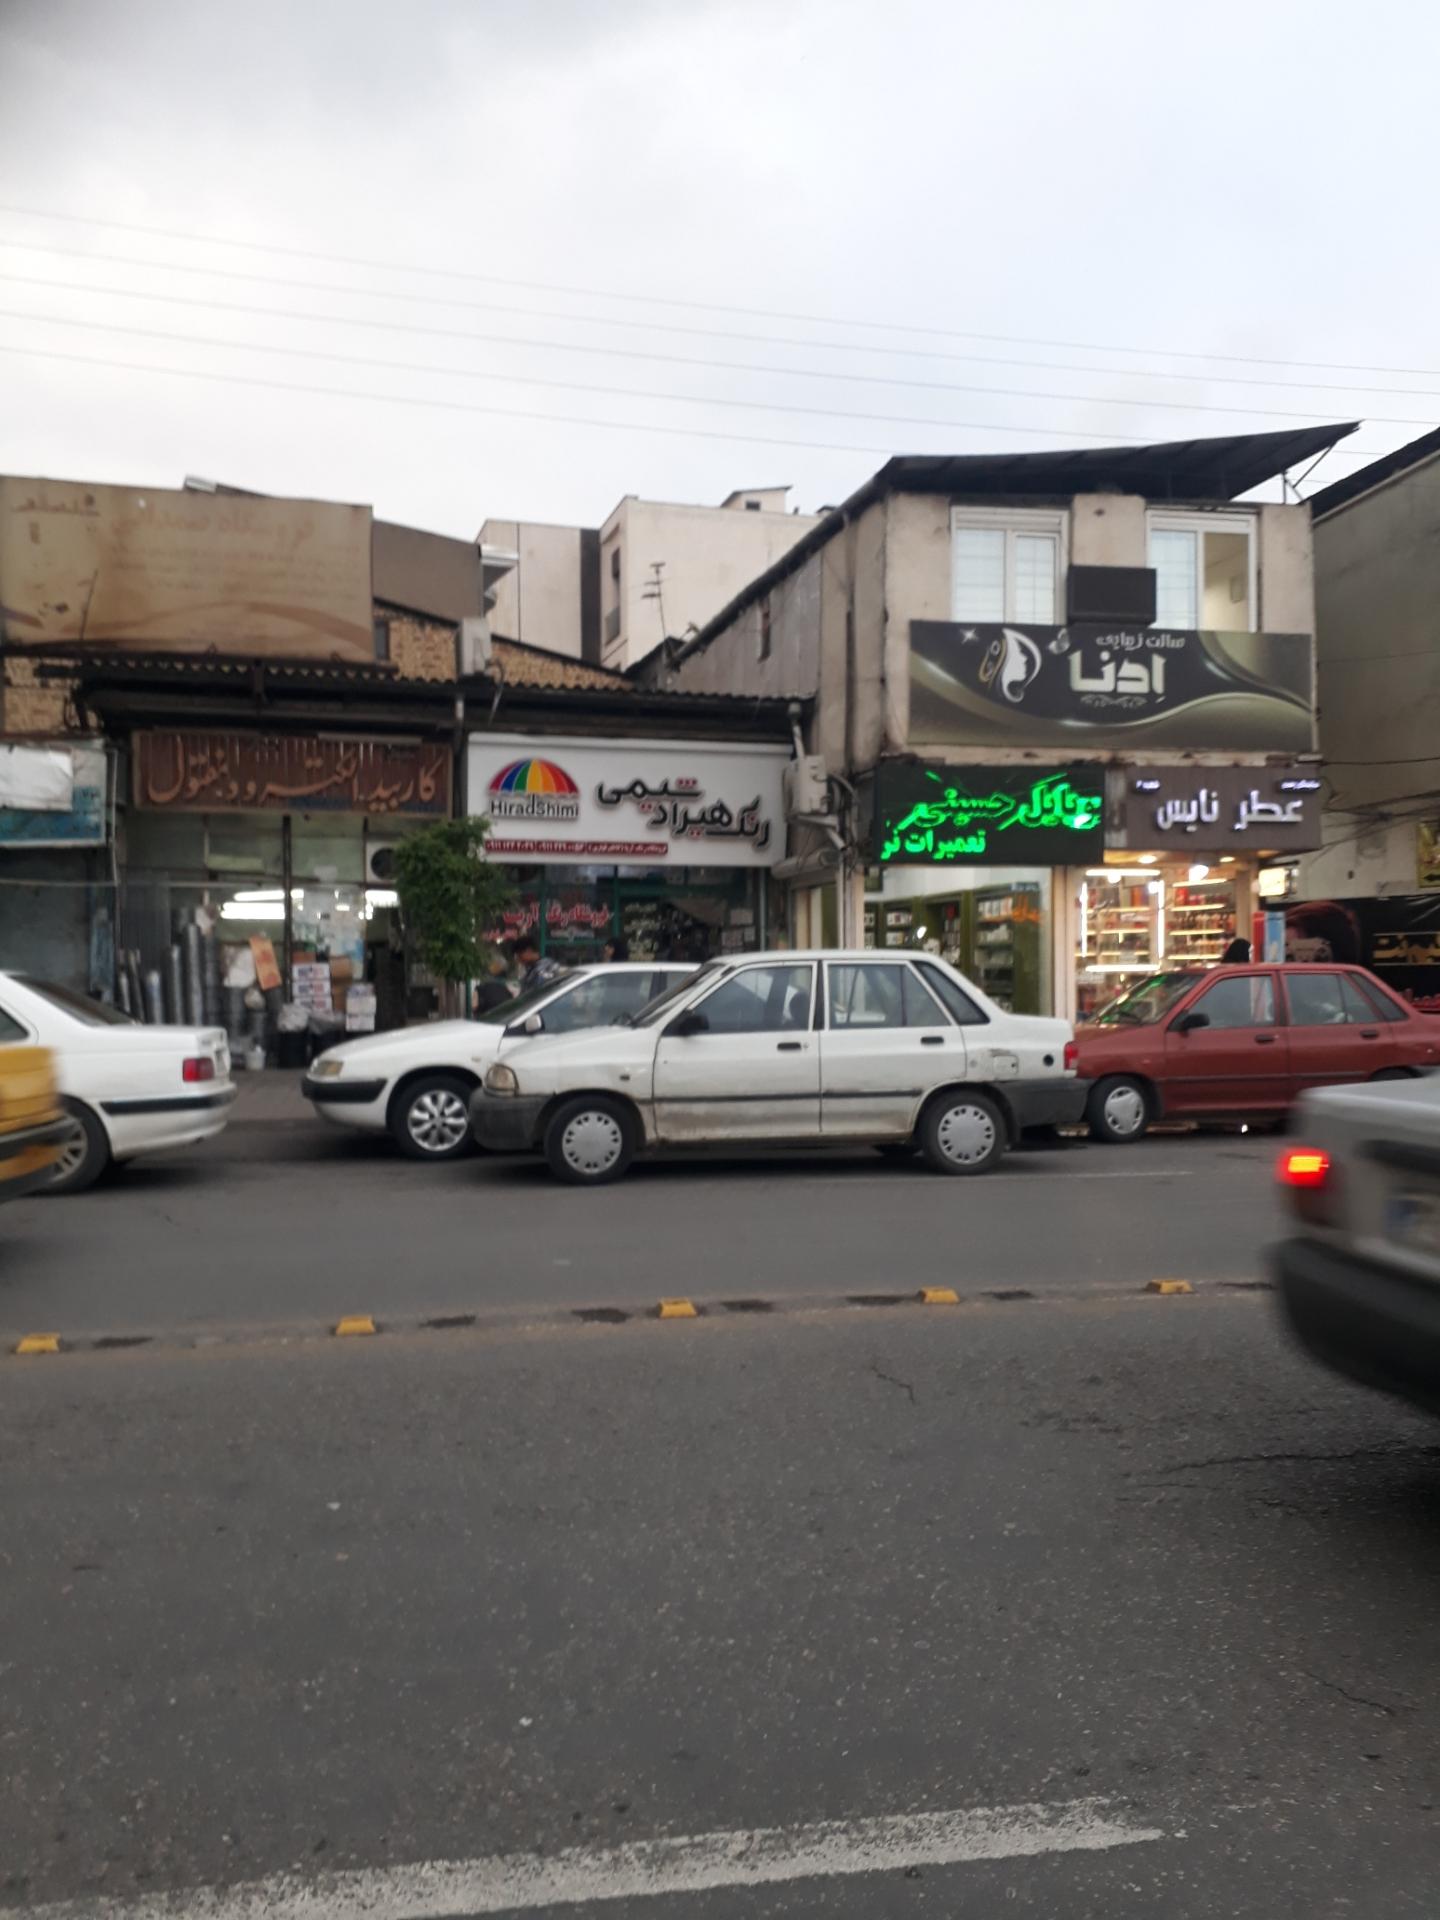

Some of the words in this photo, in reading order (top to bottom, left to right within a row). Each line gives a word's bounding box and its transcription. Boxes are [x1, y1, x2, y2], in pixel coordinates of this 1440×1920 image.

[1096, 632, 1143, 651] زیبایی
[1146, 633, 1186, 649] سالن
[369, 756, 444, 811] کاربید
[597, 777, 703, 811] شیمی
[490, 793, 579, 817] HiradShimi
[650, 799, 732, 838] هیراد
[705, 794, 770, 848] رنگ
[1157, 788, 1219, 833] نایس
[1234, 790, 1304, 831] عطر
[904, 828, 986, 860] تعمیرات
